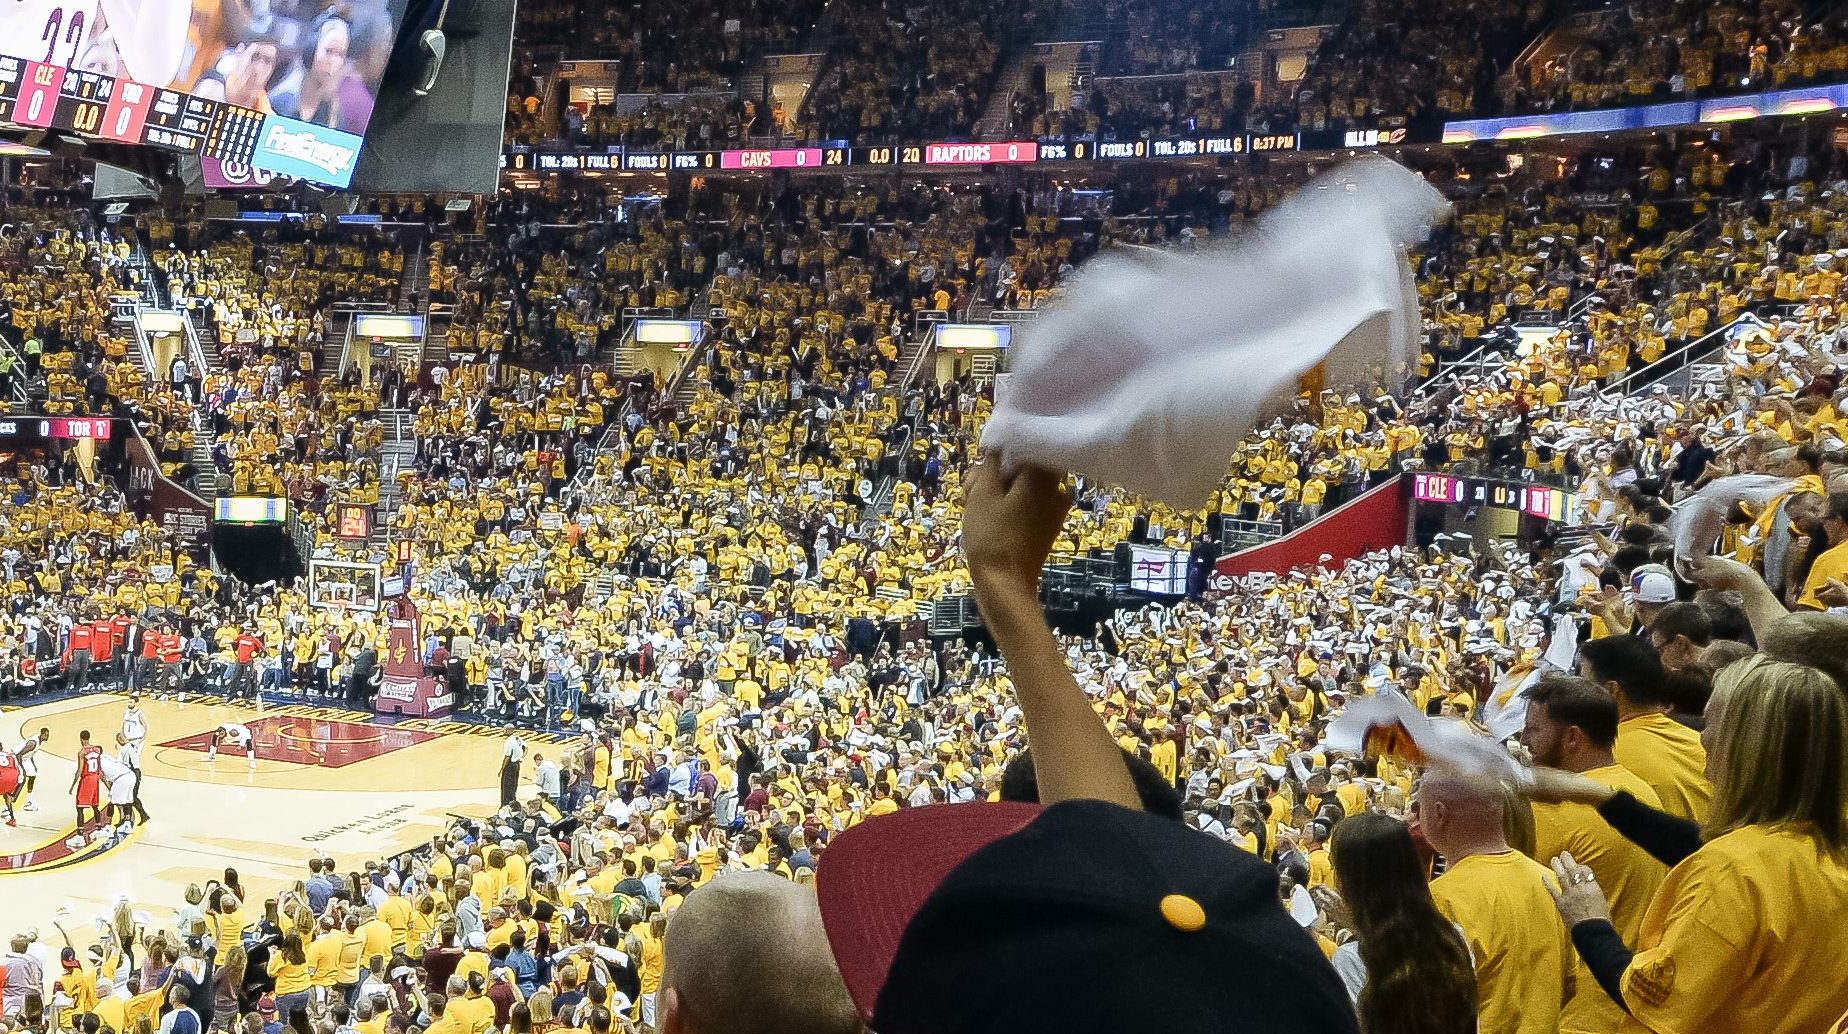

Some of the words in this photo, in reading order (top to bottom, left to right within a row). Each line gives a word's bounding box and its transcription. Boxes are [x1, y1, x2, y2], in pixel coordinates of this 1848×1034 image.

[34, 65, 55, 86] CLE
[28, 88, 44, 121] 0
[73, 103, 99, 131] 0.0
[116, 106, 132, 136] 0
[1100, 143, 1134, 157] FOULS
[1154, 142, 1176, 155] TOL:
[1206, 138, 1232, 153] FULL
[1276, 135, 1294, 149] PM
[587, 155, 610, 168] FULL
[628, 155, 658, 168] FOULS
[740, 152, 772, 167] CAVS
[796, 150, 805, 165] 0
[826, 149, 842, 165] 24
[869, 148, 890, 164] 0.0
[932, 145, 991, 162] RAPTORS
[1008, 144, 1018, 160] 0
[40, 420, 48, 436] 0
[68, 420, 91, 437] TOR
[1428, 477, 1449, 499] CLE
[1455, 480, 1464, 502] 0
[301, 820, 371, 841] Quicken
